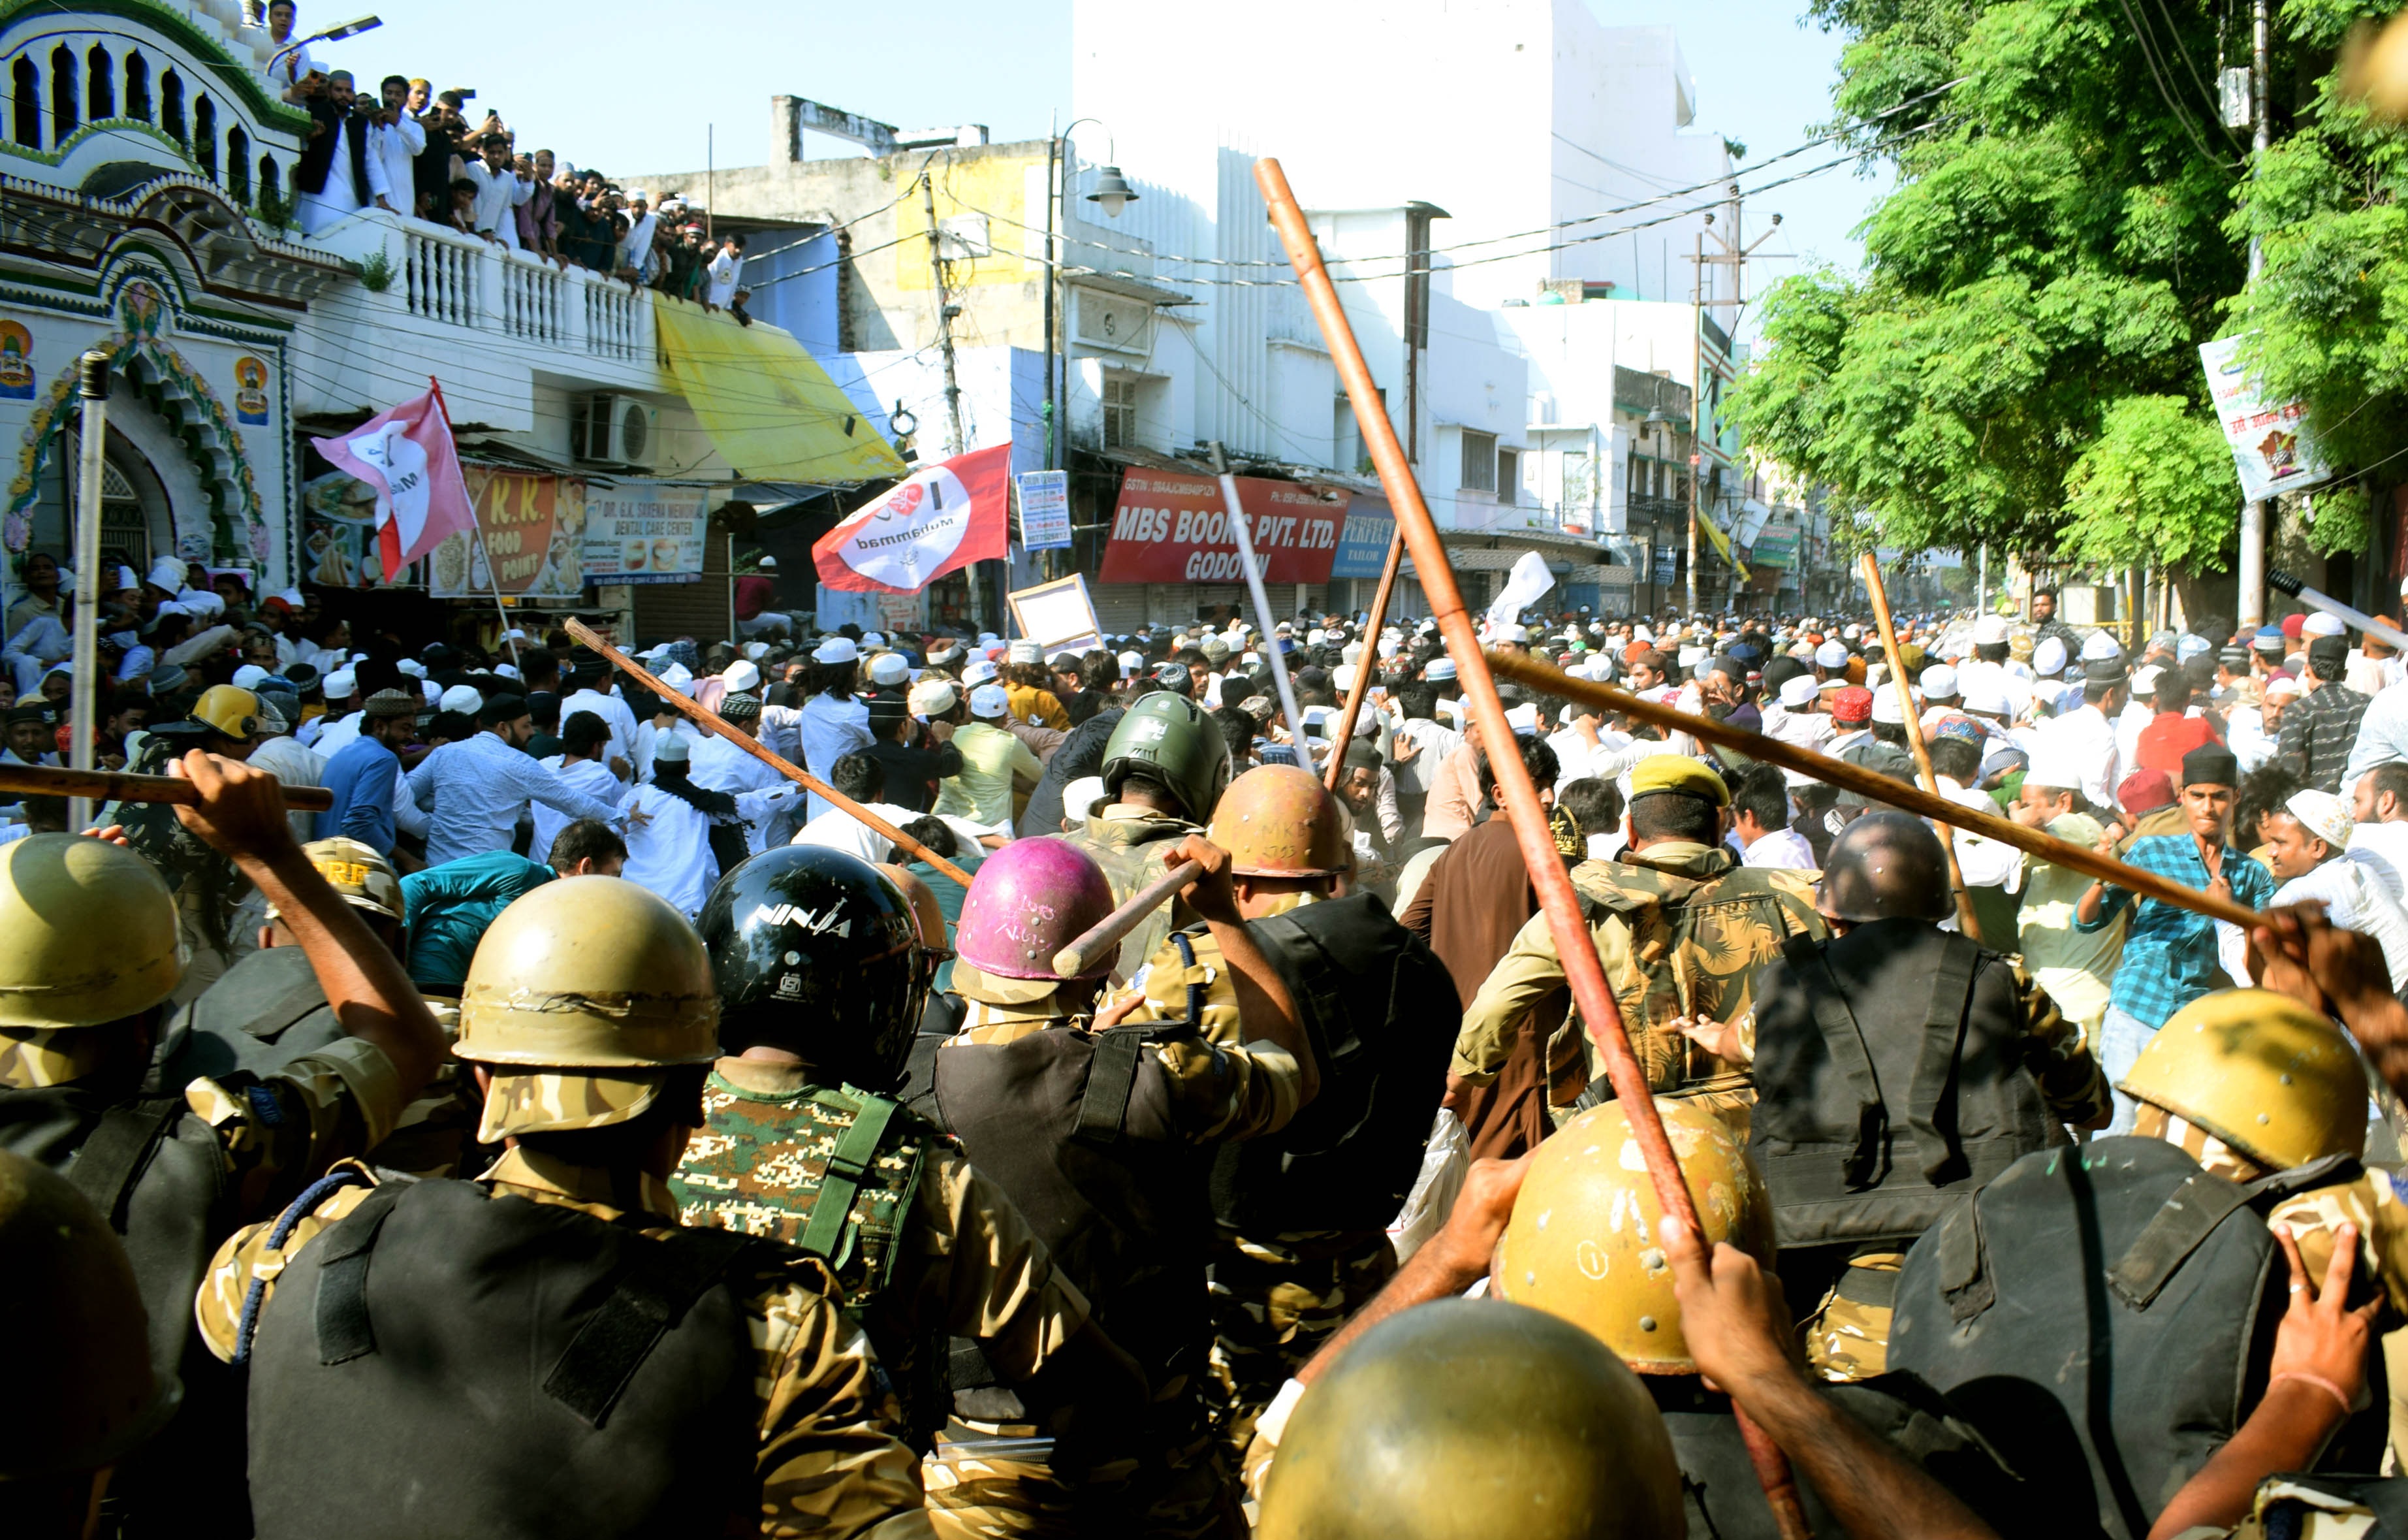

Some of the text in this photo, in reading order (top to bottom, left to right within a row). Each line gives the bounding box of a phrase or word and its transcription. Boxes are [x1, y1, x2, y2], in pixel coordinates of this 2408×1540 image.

[1124, 477, 1148, 492] GSTIN
[637, 501, 666, 519] SAXENA
[668, 503, 704, 519] MEMORIAL
[614, 521, 693, 536] DENTAL CARE CENTER
[1112, 505, 1171, 543] MBS
[1254, 515, 1297, 548] PVT.
[1299, 519, 1335, 549] LTD.
[1341, 515, 1395, 545] PERFECT
[488, 530, 522, 556] FOOD
[1348, 549, 1379, 562] TAILOR
[501, 553, 539, 583] POINT
[746, 897, 851, 938] NINJA
